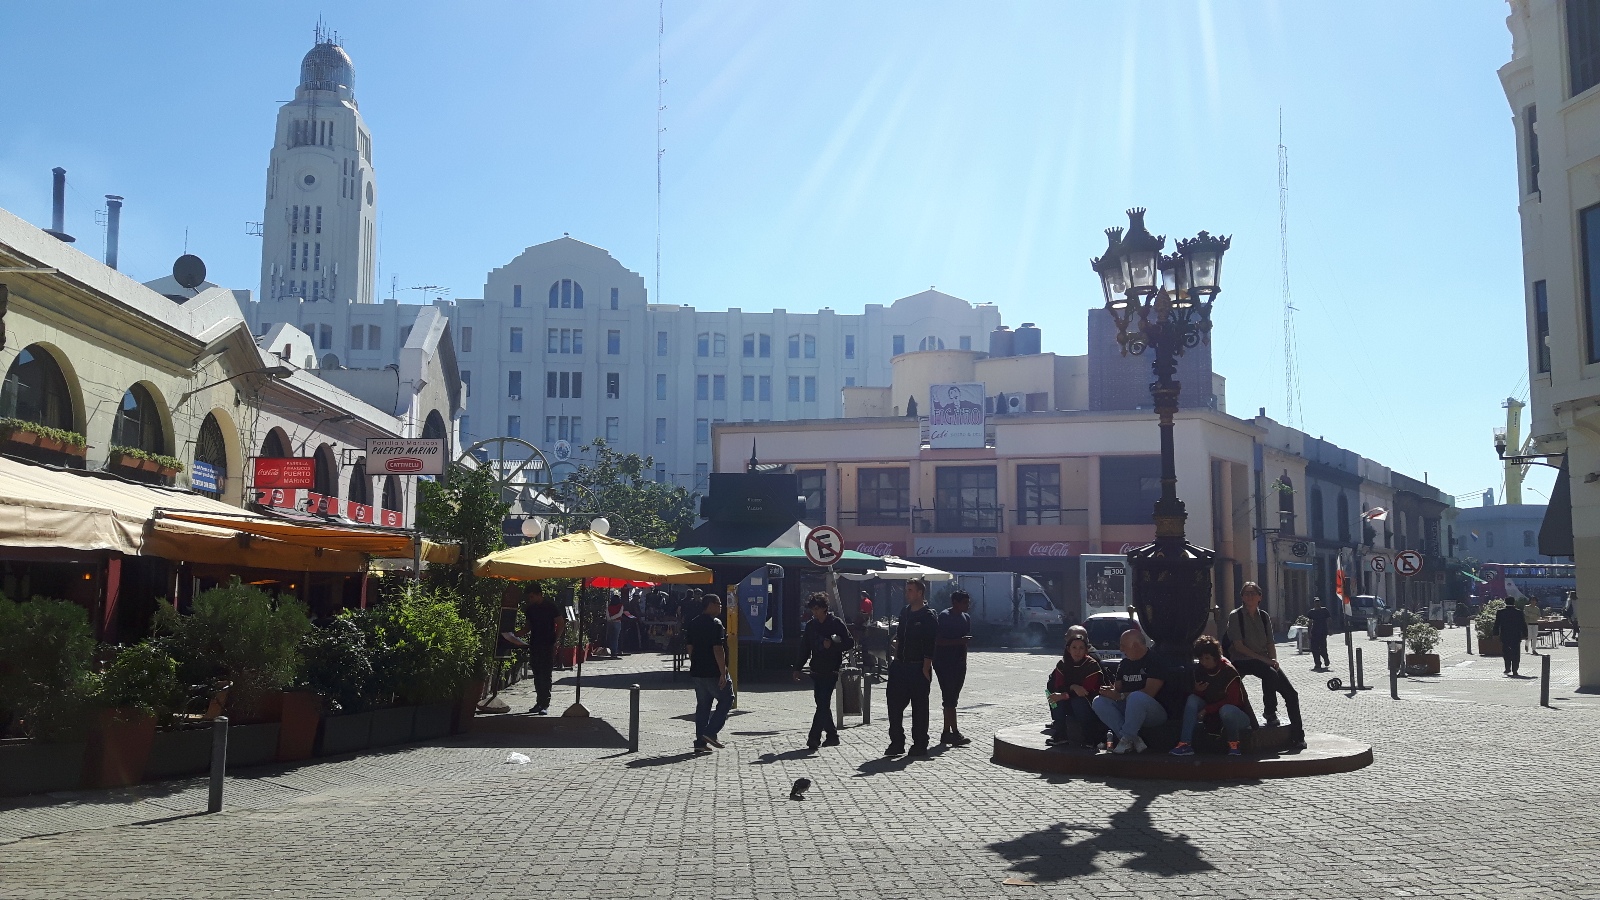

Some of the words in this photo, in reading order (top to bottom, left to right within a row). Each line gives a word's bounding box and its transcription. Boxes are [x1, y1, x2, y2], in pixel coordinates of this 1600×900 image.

[933, 408, 981, 425] FIGARO
[371, 446, 405, 455] PUERTO
[405, 446, 438, 455] MARINO
[1029, 542, 1070, 556] Coca-Cola
